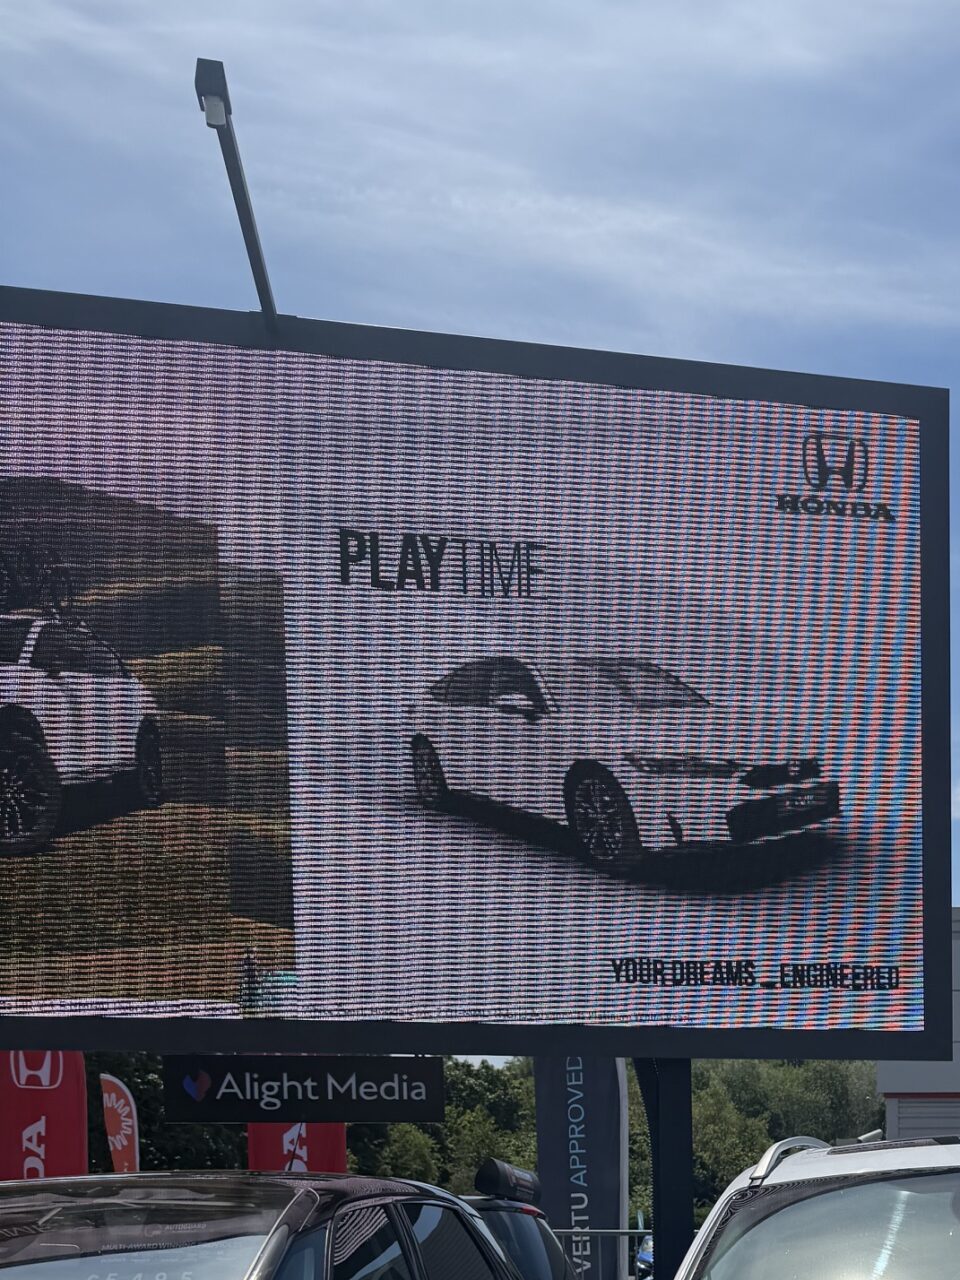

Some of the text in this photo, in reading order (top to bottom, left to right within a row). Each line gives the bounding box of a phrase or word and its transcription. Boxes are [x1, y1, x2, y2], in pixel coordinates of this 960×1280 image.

[777, 494, 896, 521] HONDA
[339, 527, 549, 601] PLAYTIME
[611, 957, 664, 985] YOUR
[671, 959, 756, 987] DREAMS
[779, 961, 900, 991] ENGINEERED
[215, 1072, 427, 1110] Alight Media
